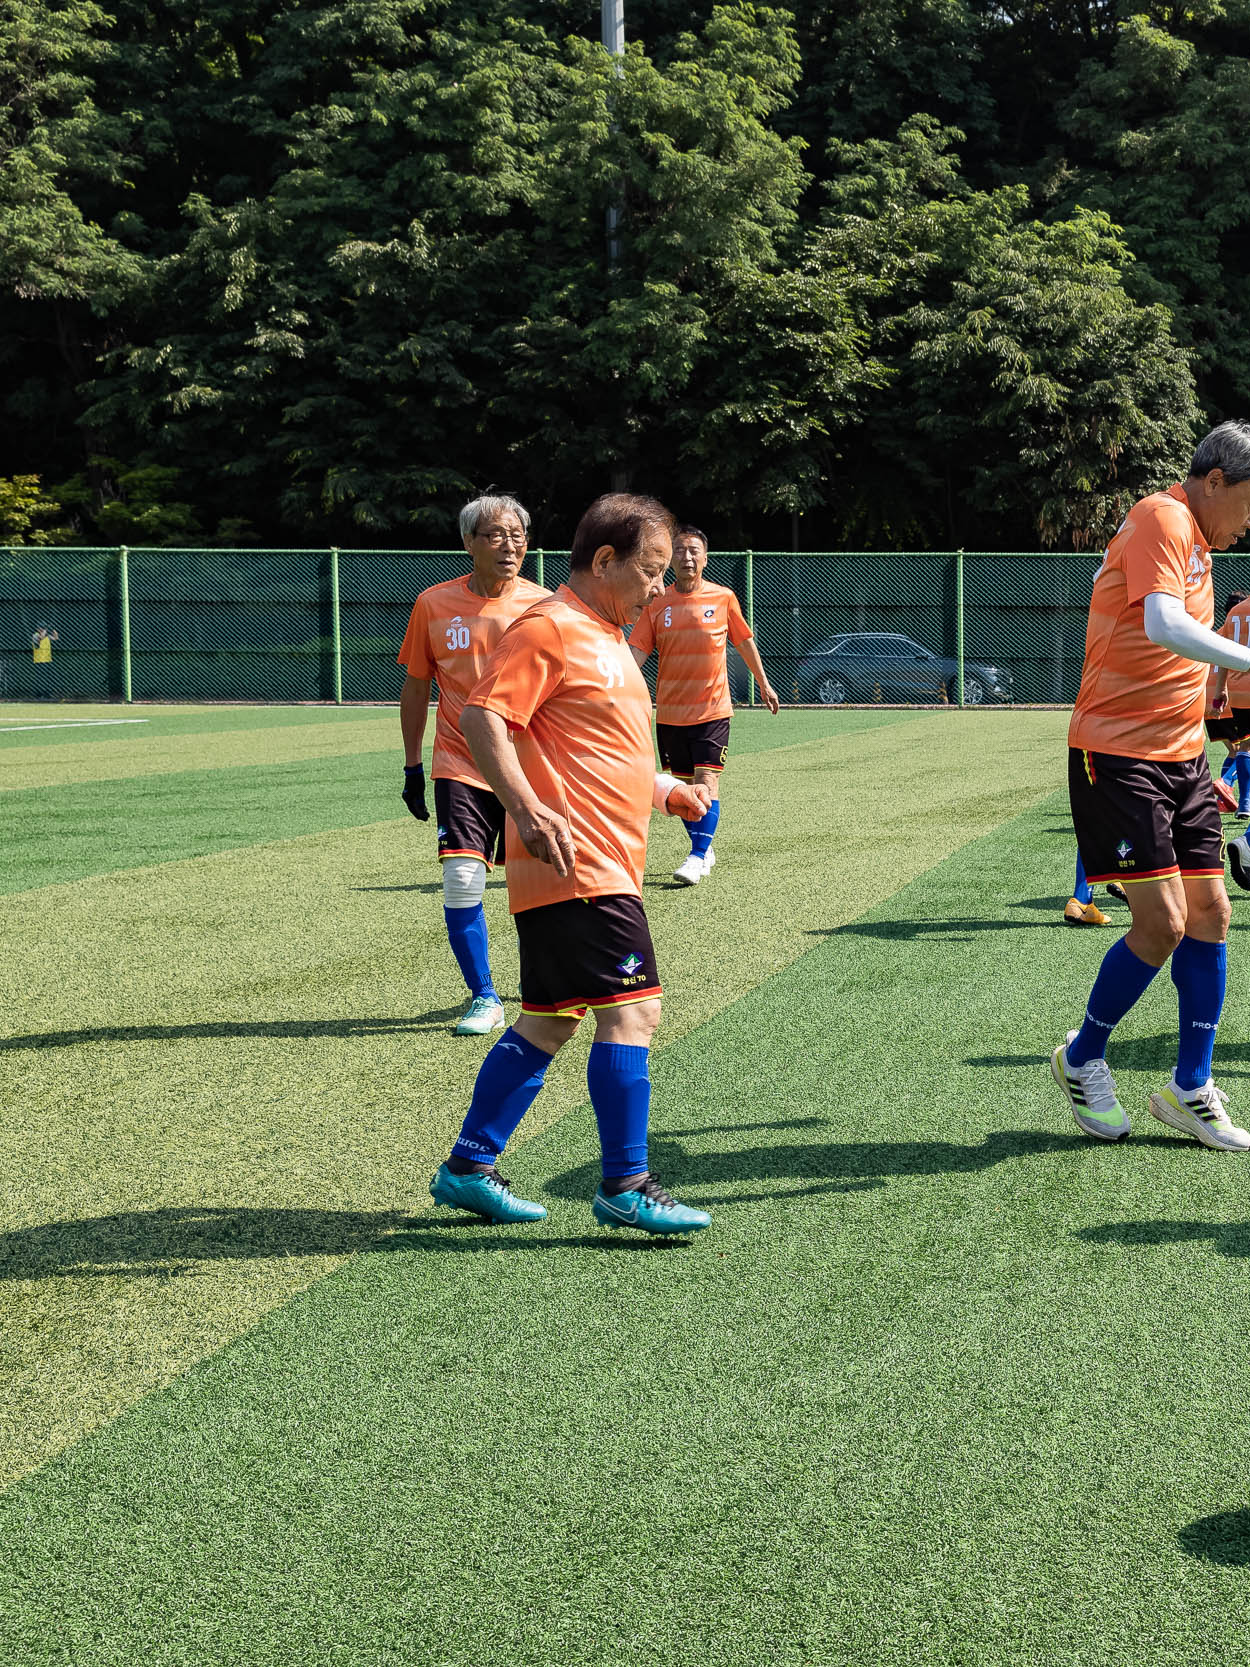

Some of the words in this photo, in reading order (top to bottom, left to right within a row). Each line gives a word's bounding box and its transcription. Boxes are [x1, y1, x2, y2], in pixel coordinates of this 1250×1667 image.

[664, 613, 672, 628] 5
[446, 627, 470, 651] 30
[637, 974, 647, 983] 70
